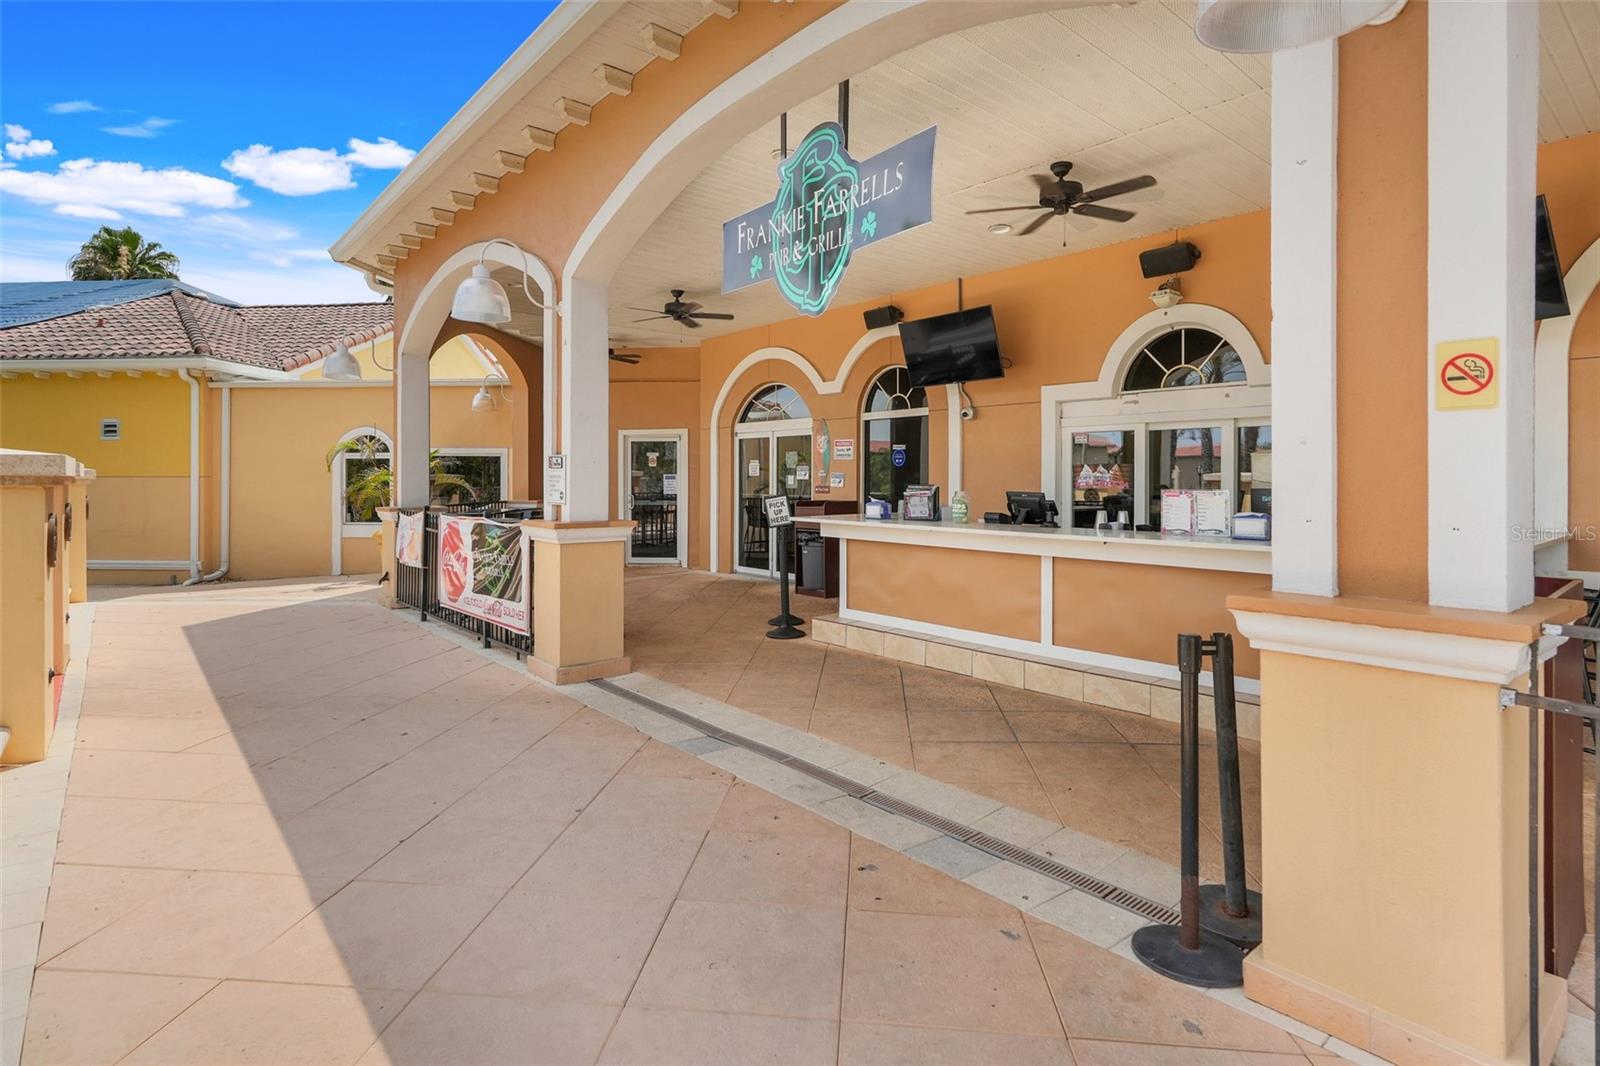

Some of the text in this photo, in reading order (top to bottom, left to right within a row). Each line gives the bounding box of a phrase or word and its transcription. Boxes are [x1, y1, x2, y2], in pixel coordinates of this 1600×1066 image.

[737, 161, 904, 255] FRANKIE FARRELLS
[768, 223, 853, 271] PUB & GRILLE
[768, 500, 786, 510] PICK
[773, 508, 784, 516] UP
[770, 514, 789, 524] HERE
